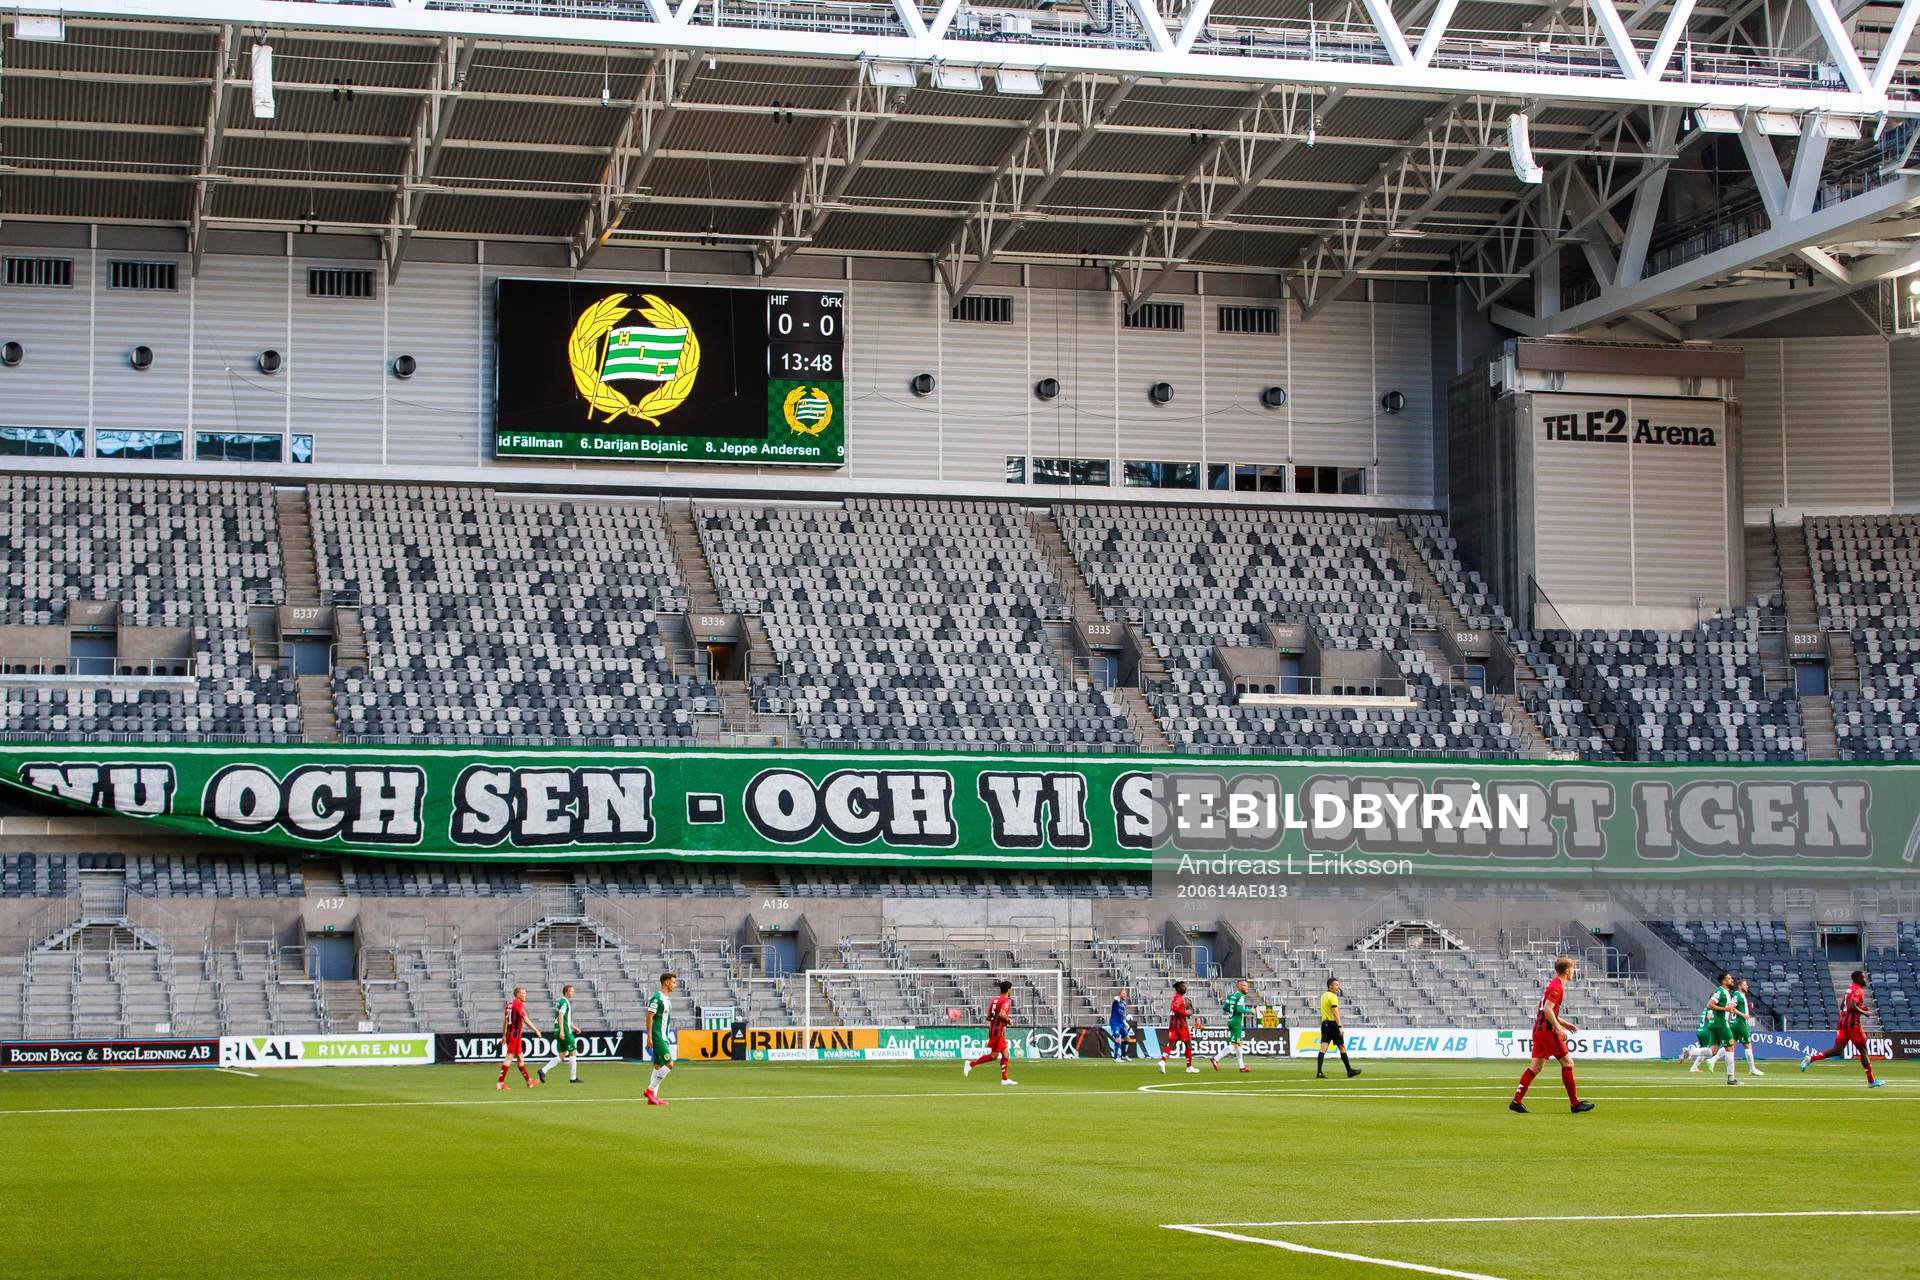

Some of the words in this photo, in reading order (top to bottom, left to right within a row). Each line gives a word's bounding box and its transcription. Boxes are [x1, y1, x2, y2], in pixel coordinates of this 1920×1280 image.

[770, 295, 789, 306] HIF
[820, 295, 842, 308] ÖFK
[778, 313, 792, 335] 0
[820, 314, 834, 336] 0
[781, 352, 833, 372] 13:48
[1543, 408, 1628, 443] TELE2
[1632, 419, 1717, 447] Arena
[513, 435, 563, 448] Fällman
[580, 437, 592, 449] 6.
[594, 438, 638, 452] Darijan
[641, 439, 689, 453] Bojanic
[705, 441, 717, 453] 8.
[720, 442, 758, 456] Jeppe
[761, 443, 820, 456] Andersen
[293, 608, 319, 619] B337
[701, 616, 726, 627] B336
[1088, 625, 1111, 635] B335
[1457, 633, 1479, 643] B334
[1794, 634, 1818, 645] B333
[22, 763, 175, 817] NU
[205, 766, 424, 843] OCH
[452, 766, 654, 845] SEN
[745, 769, 957, 848] OCH
[978, 771, 1090, 849] VI
[1112, 773, 1284, 851] SES
[1633, 780, 1872, 858] IGEN
[316, 898, 345, 910] A137
[762, 898, 790, 909] A136
[1182, 900, 1208, 911] A135
[1583, 903, 1607, 913] A134
[1824, 907, 1850, 918] A133
[225, 1038, 299, 1060] RIVAL
[318, 1043, 412, 1056] RIVARE.NU
[1347, 1036, 1367, 1051] EL
[1373, 1036, 1438, 1051] LINJEN
[1443, 1036, 1468, 1052] AB
[1593, 1036, 1643, 1053] FÄRG
[1775, 1036, 1801, 1052] RÖR
[50, 1048, 82, 1061] BYGG
[87, 1048, 98, 1060] &
[189, 1046, 210, 1059] AB
[824, 1050, 860, 1058] KVARNEN
[919, 1050, 956, 1058] KVARNEN
